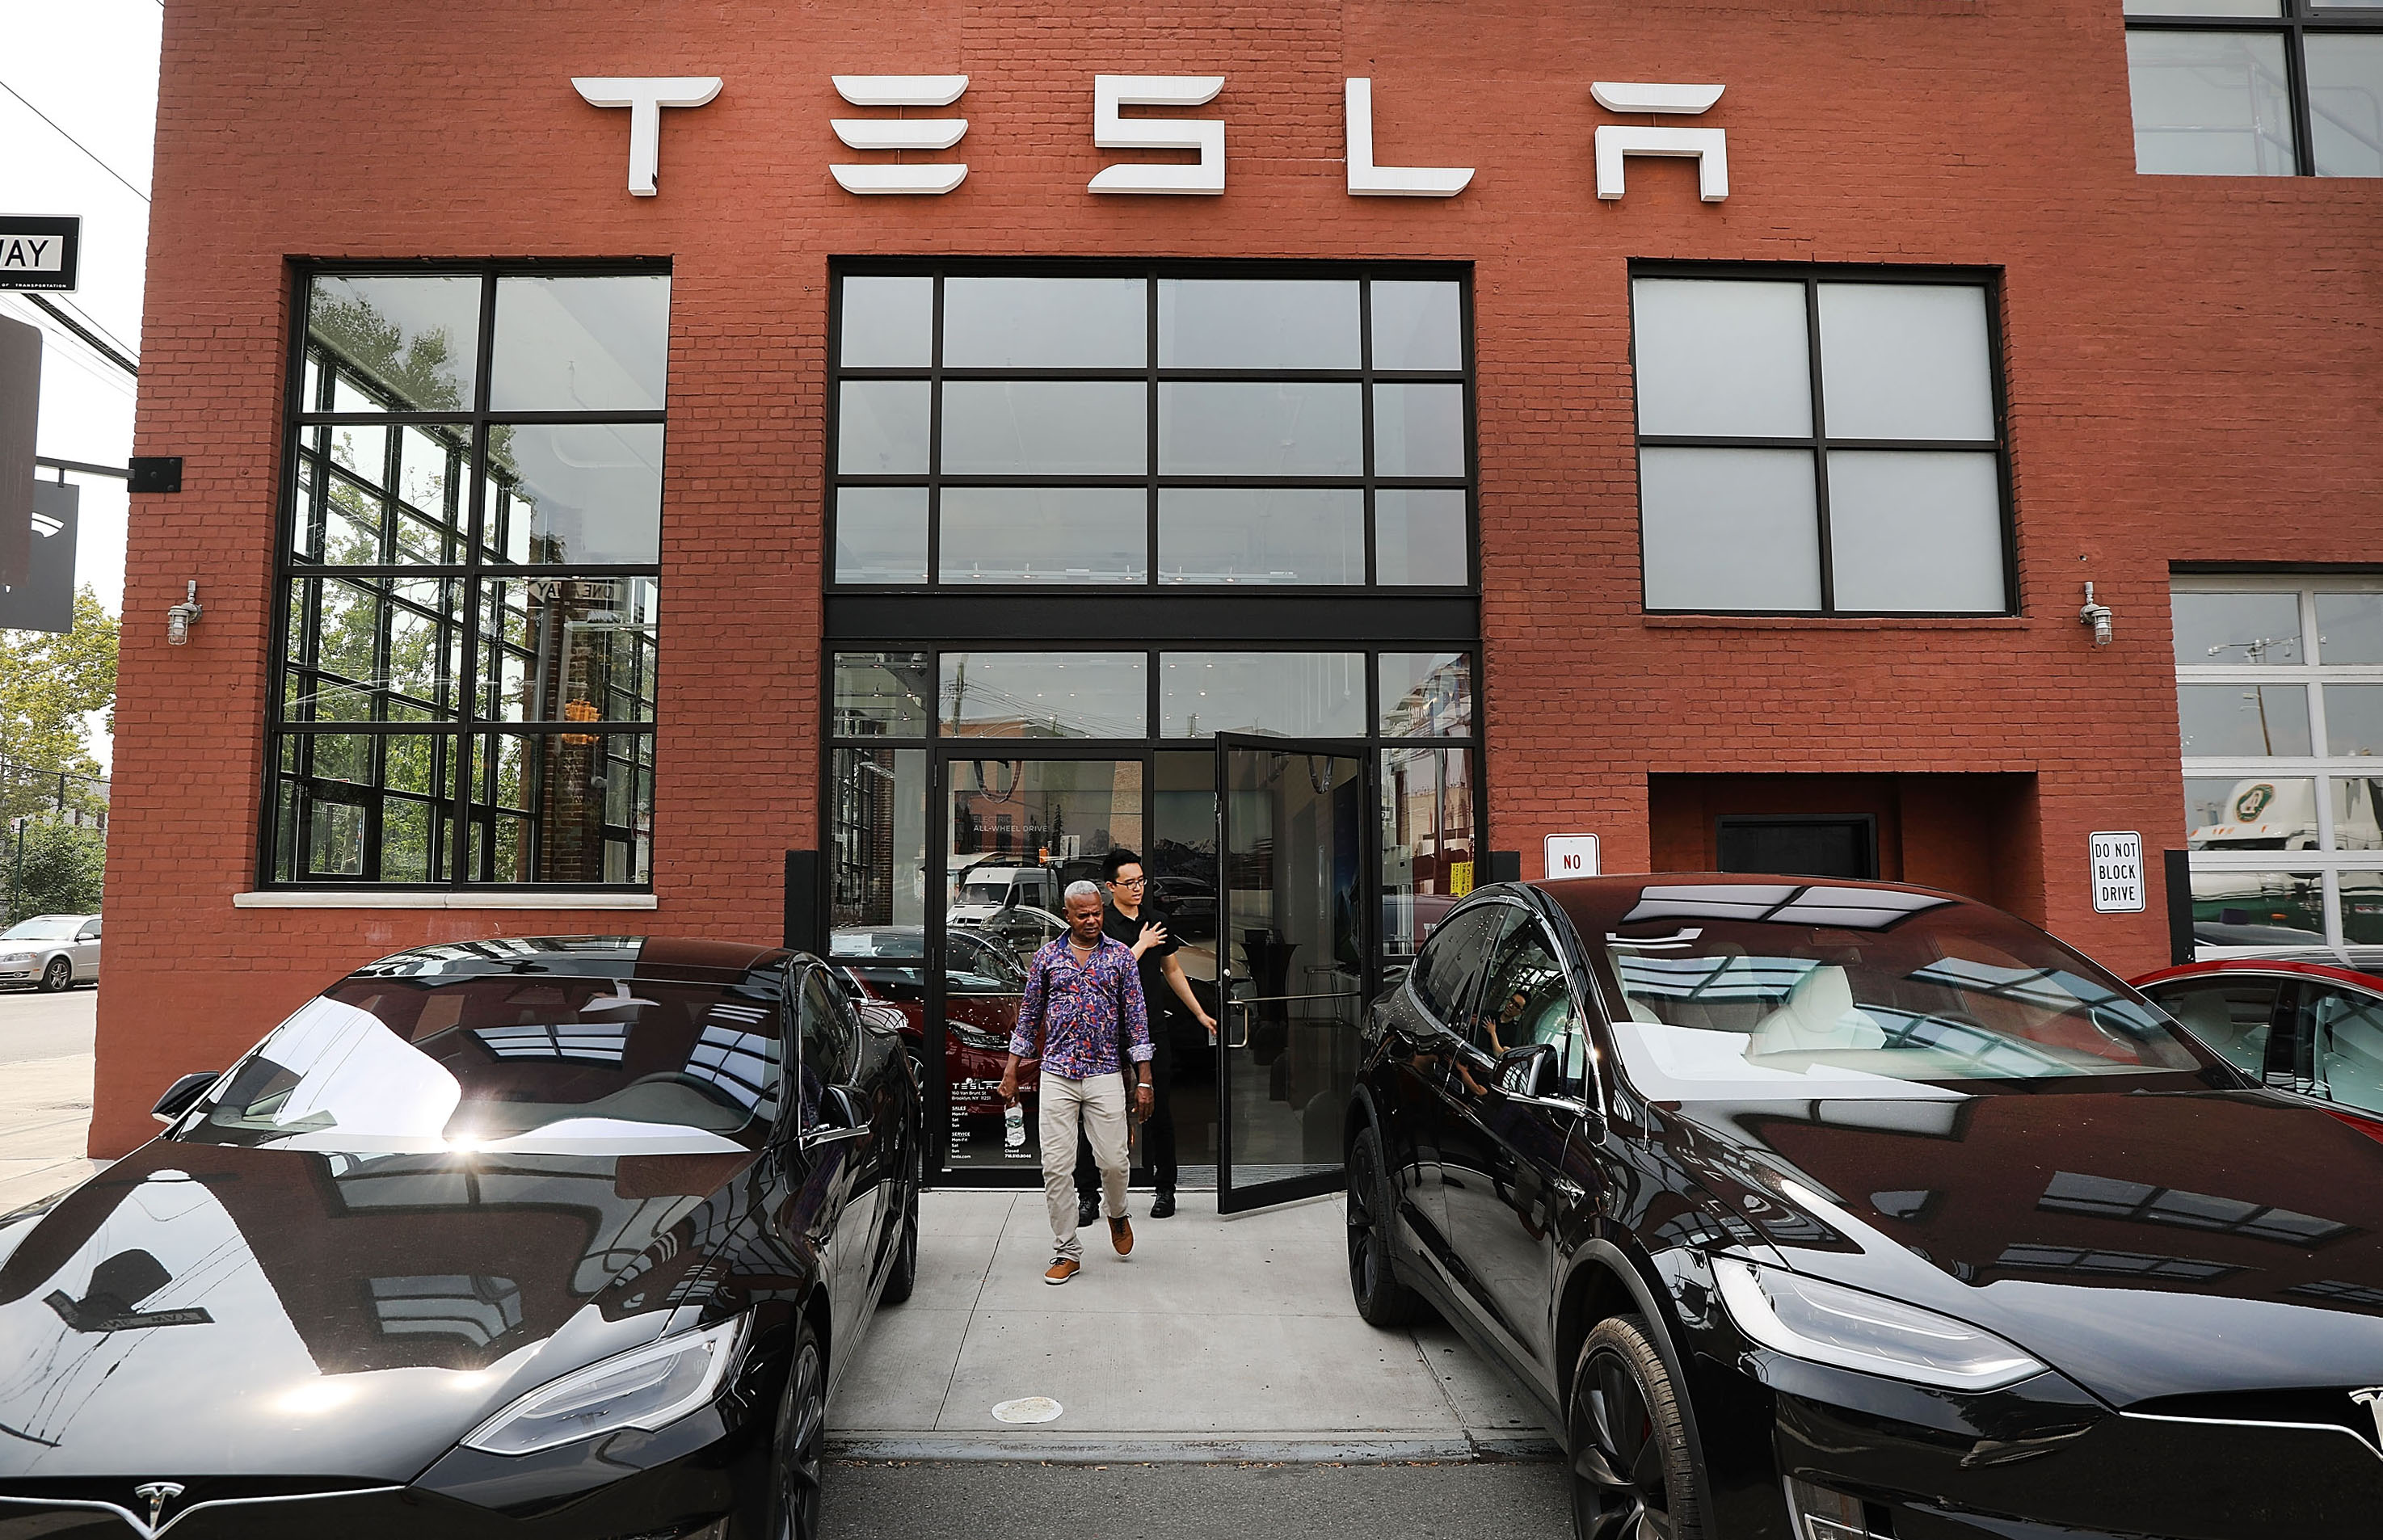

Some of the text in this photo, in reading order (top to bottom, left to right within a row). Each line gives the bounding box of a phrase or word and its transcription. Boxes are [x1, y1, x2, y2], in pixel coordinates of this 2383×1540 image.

[570, 74, 1729, 202] TESLA
[0, 238, 49, 267] AY
[2095, 843, 2136, 857] DO NOT
[1564, 854, 1581, 869] NO
[2099, 865, 2136, 880] BLOCK
[2102, 886, 2136, 901] DRIVE
